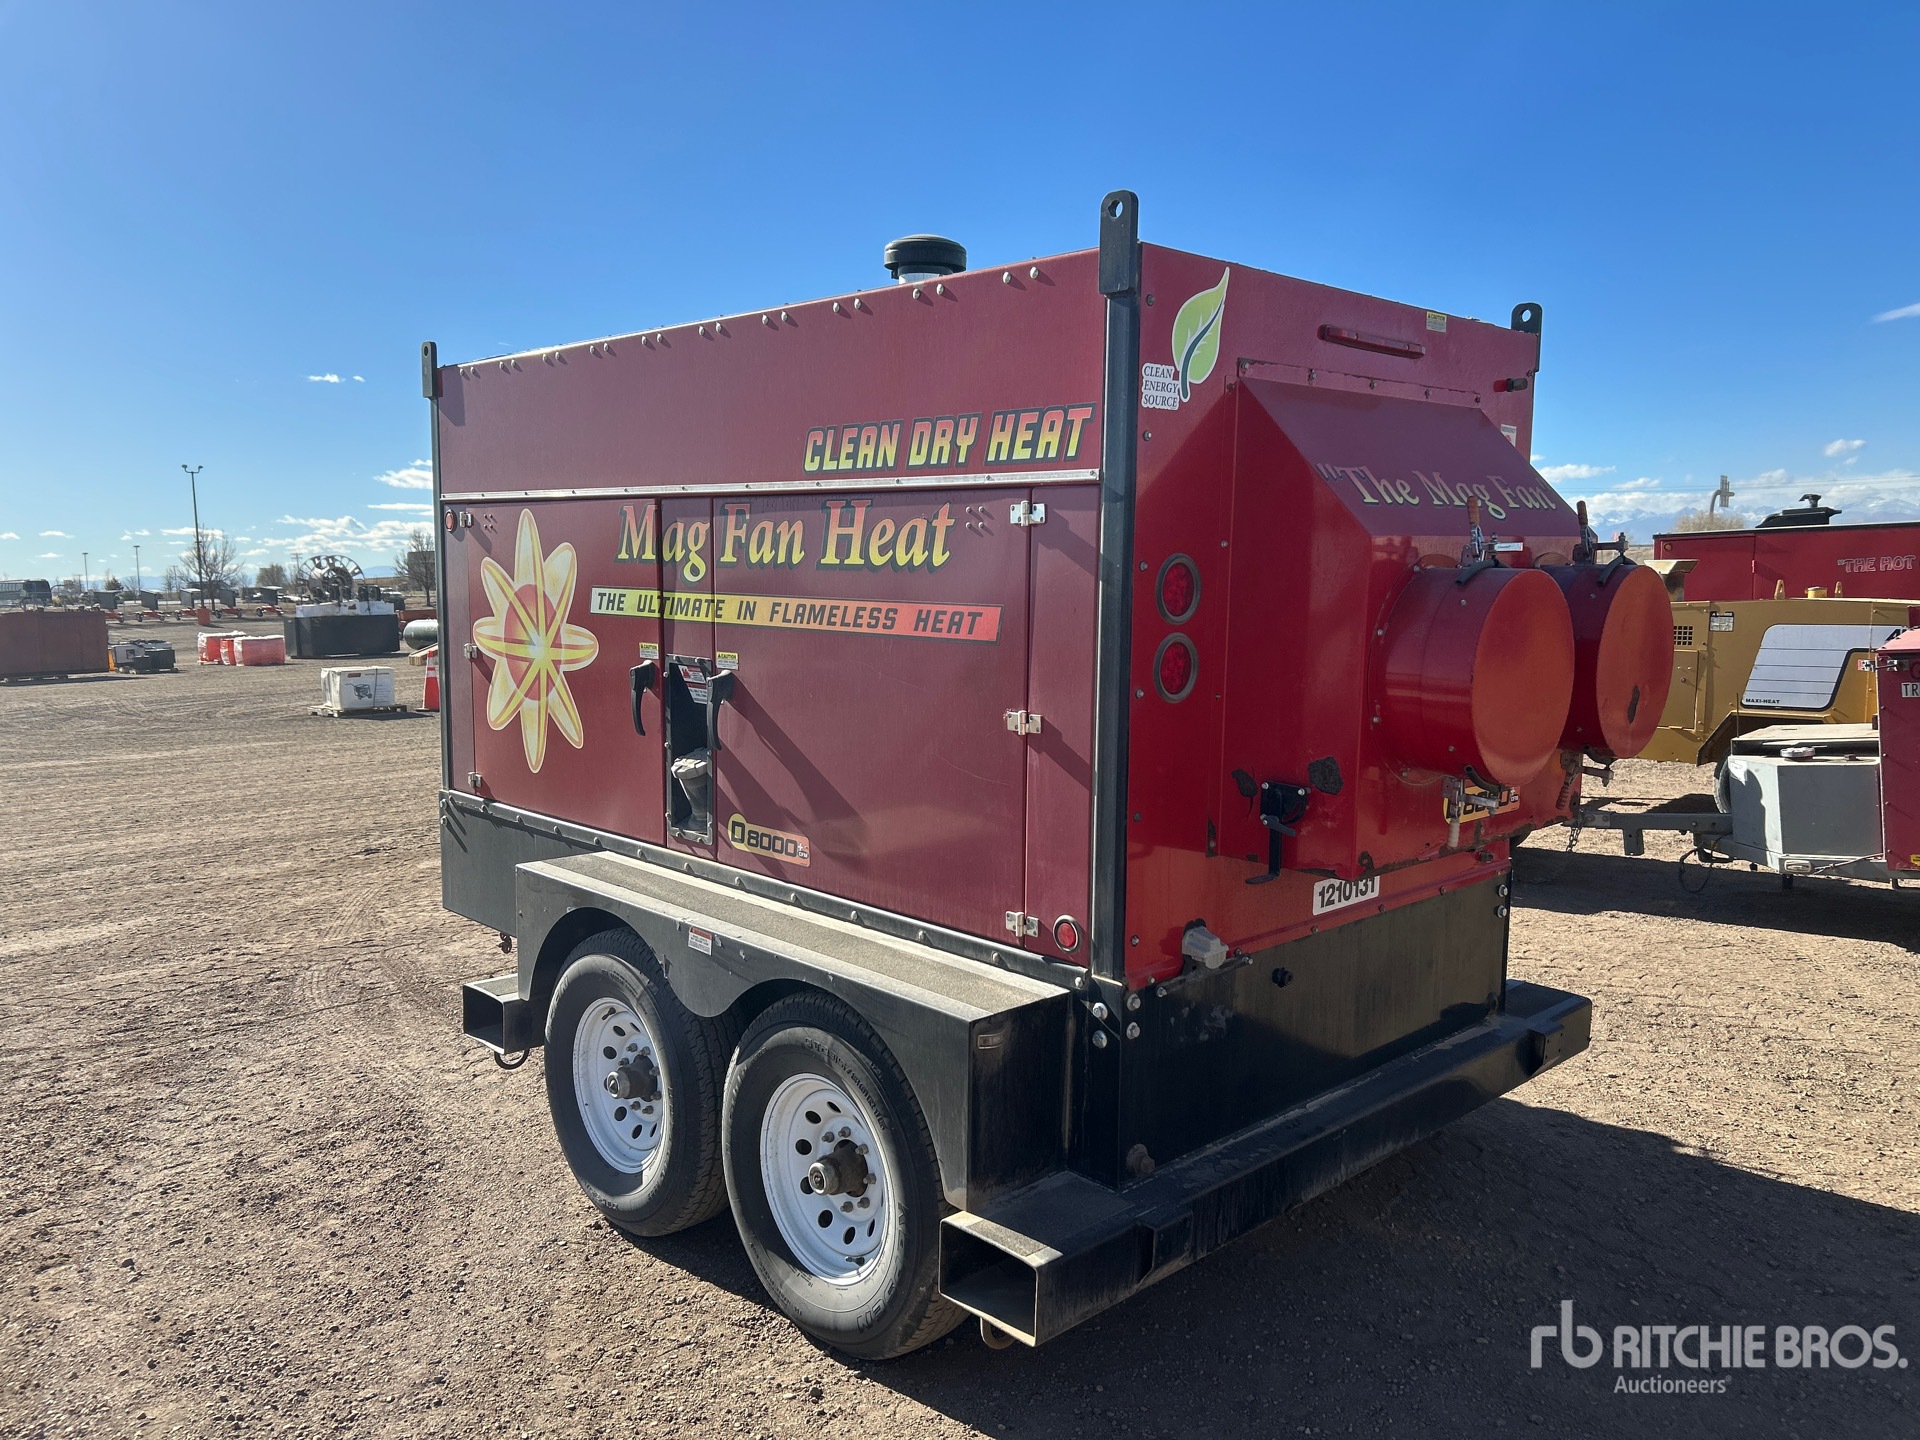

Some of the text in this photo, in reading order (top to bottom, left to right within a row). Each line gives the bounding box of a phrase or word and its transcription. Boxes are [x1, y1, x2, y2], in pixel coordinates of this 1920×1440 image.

[1144, 366, 1173, 378] CLEAN
[1144, 380, 1179, 393] ENERGY
[1143, 394, 1178, 407] SOURCE
[803, 404, 1095, 473] CLEAN DRY HEAT
[1412, 470, 1506, 519] Mag
[616, 499, 956, 582] Mag Fan Heat
[1880, 554, 1917, 571] HOT
[598, 592, 984, 635] THE ULTIMATE IN FLAMELESS HEAT
[1319, 877, 1376, 908] 1210131
